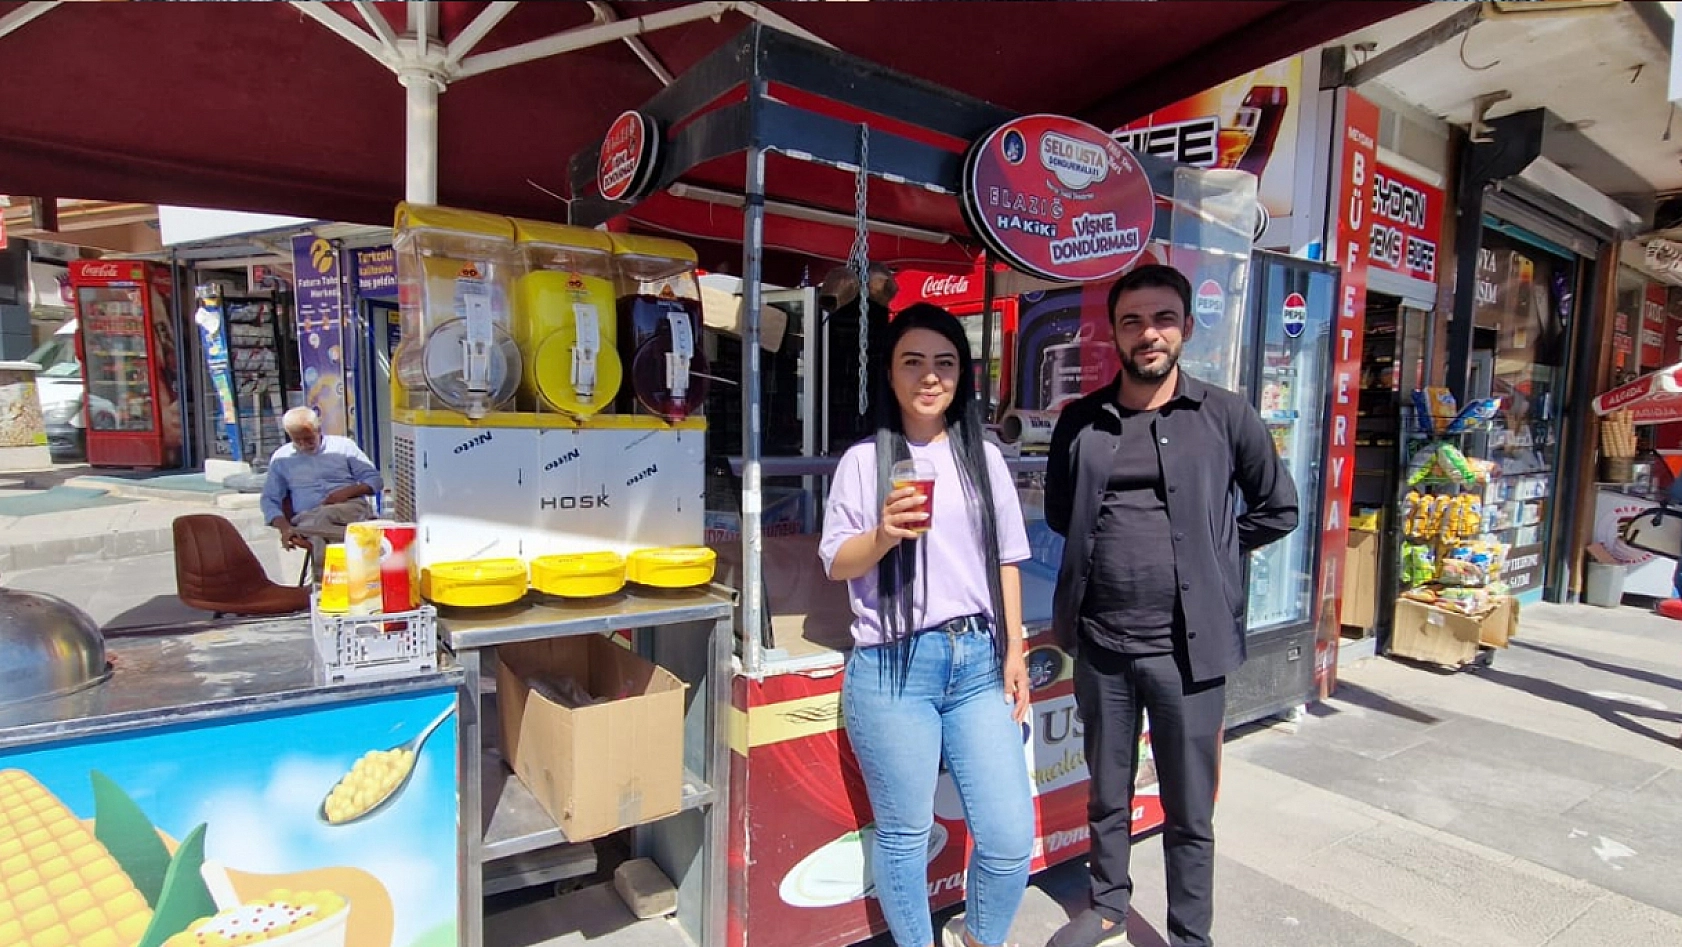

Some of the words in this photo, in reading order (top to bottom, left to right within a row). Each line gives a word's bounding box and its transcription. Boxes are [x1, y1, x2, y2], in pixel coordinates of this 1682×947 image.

[1044, 138, 1073, 156] SELO
[1075, 146, 1103, 168] USTA
[989, 185, 1064, 219] ELAZIĞ
[1074, 214, 1114, 237] VİŞNE
[1052, 231, 1138, 260] DONDURMASI
[921, 275, 969, 298] Coca-Cola
[1198, 298, 1222, 310] PEPSI
[1284, 310, 1305, 320] PEPSI
[1326, 151, 1365, 531] BÜFETERYA
[453, 430, 493, 455] Nitto
[544, 448, 580, 472] Nitto
[625, 464, 659, 487] Nitto
[541, 494, 610, 510] HOSK
